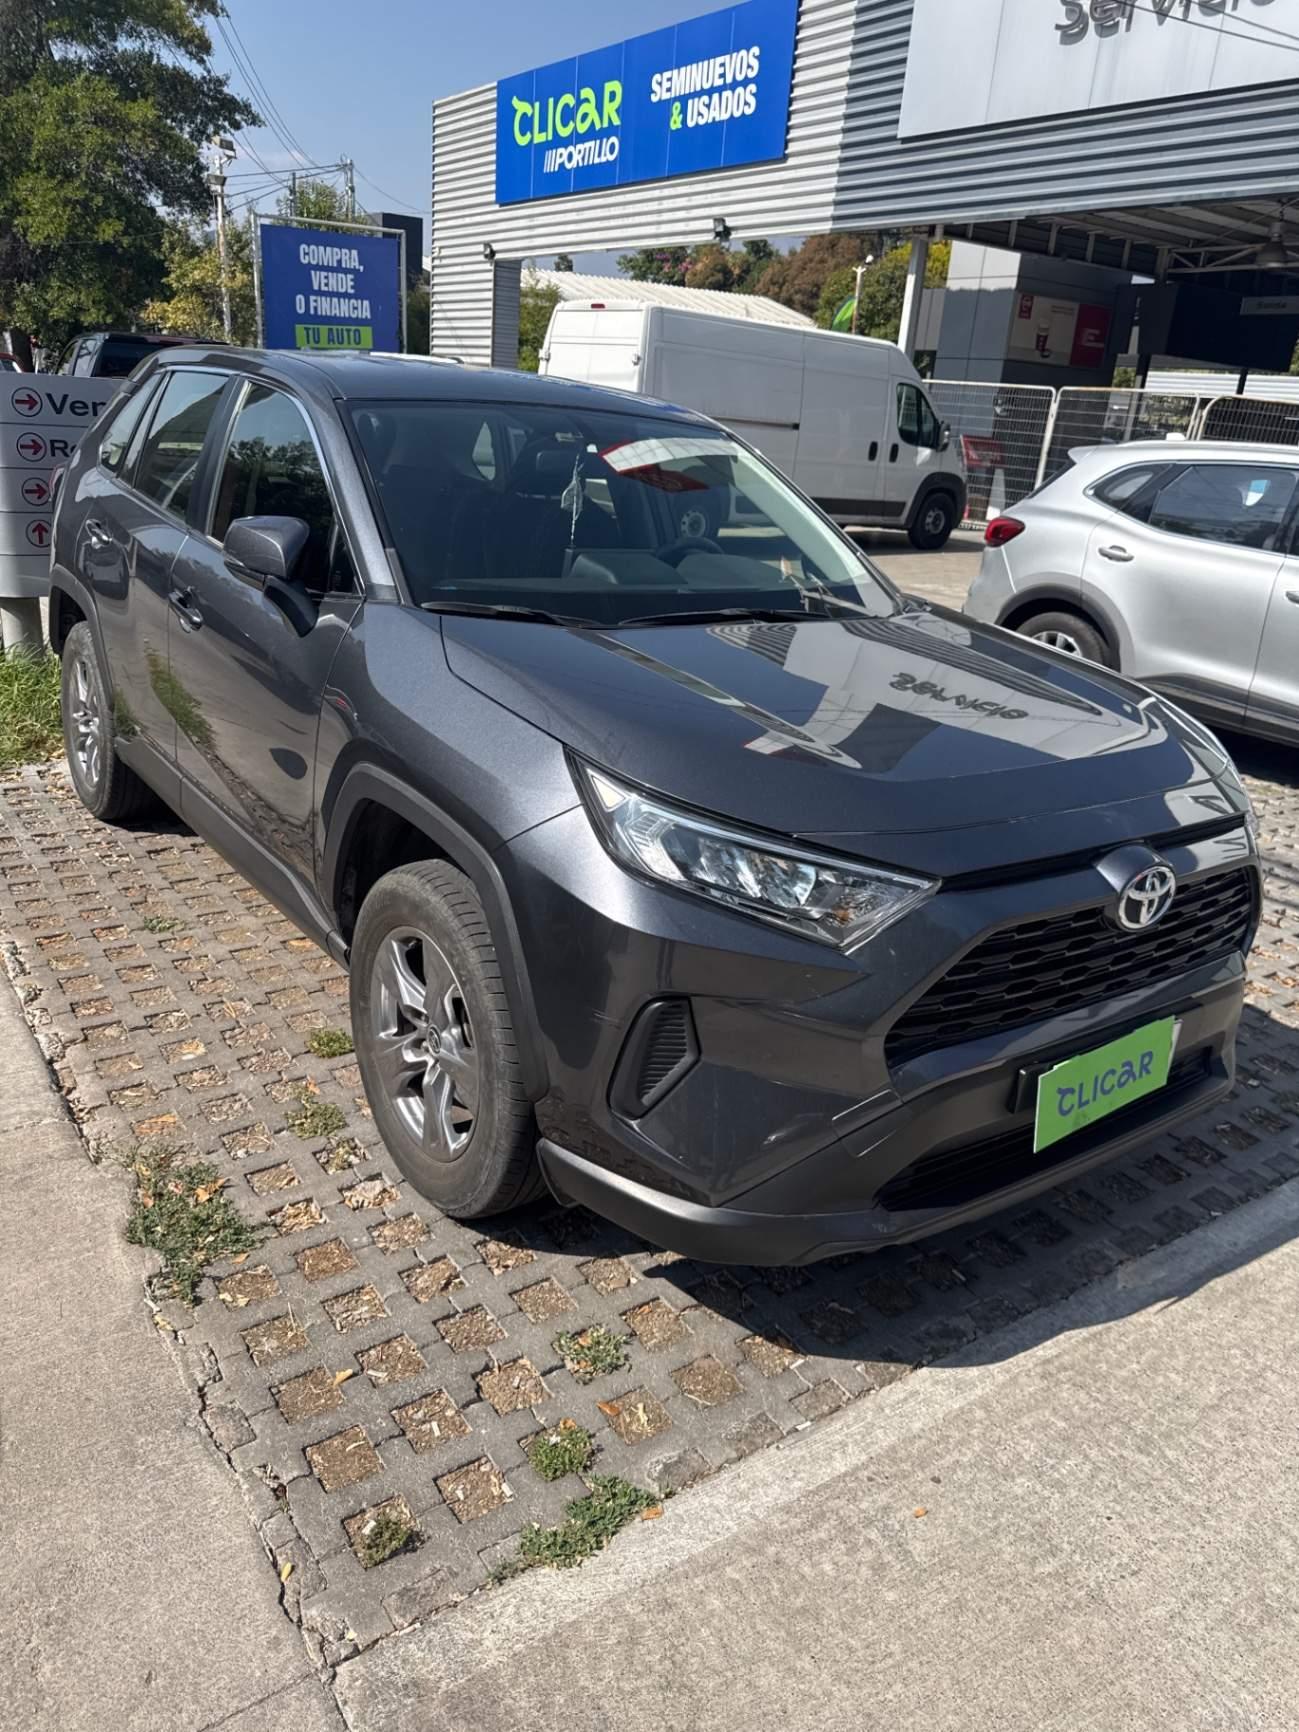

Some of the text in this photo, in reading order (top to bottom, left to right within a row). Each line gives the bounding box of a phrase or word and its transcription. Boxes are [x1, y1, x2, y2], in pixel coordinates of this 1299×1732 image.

[650, 46, 760, 103] SEMINUEVOS
[670, 84, 757, 130] & USADOS
[555, 136, 620, 172] PORTILLO
[300, 244, 364, 272] COMPRA,
[311, 270, 355, 293] VENDE
[295, 294, 371, 319] O FINANCIA
[304, 327, 361, 345] TU AUTO
